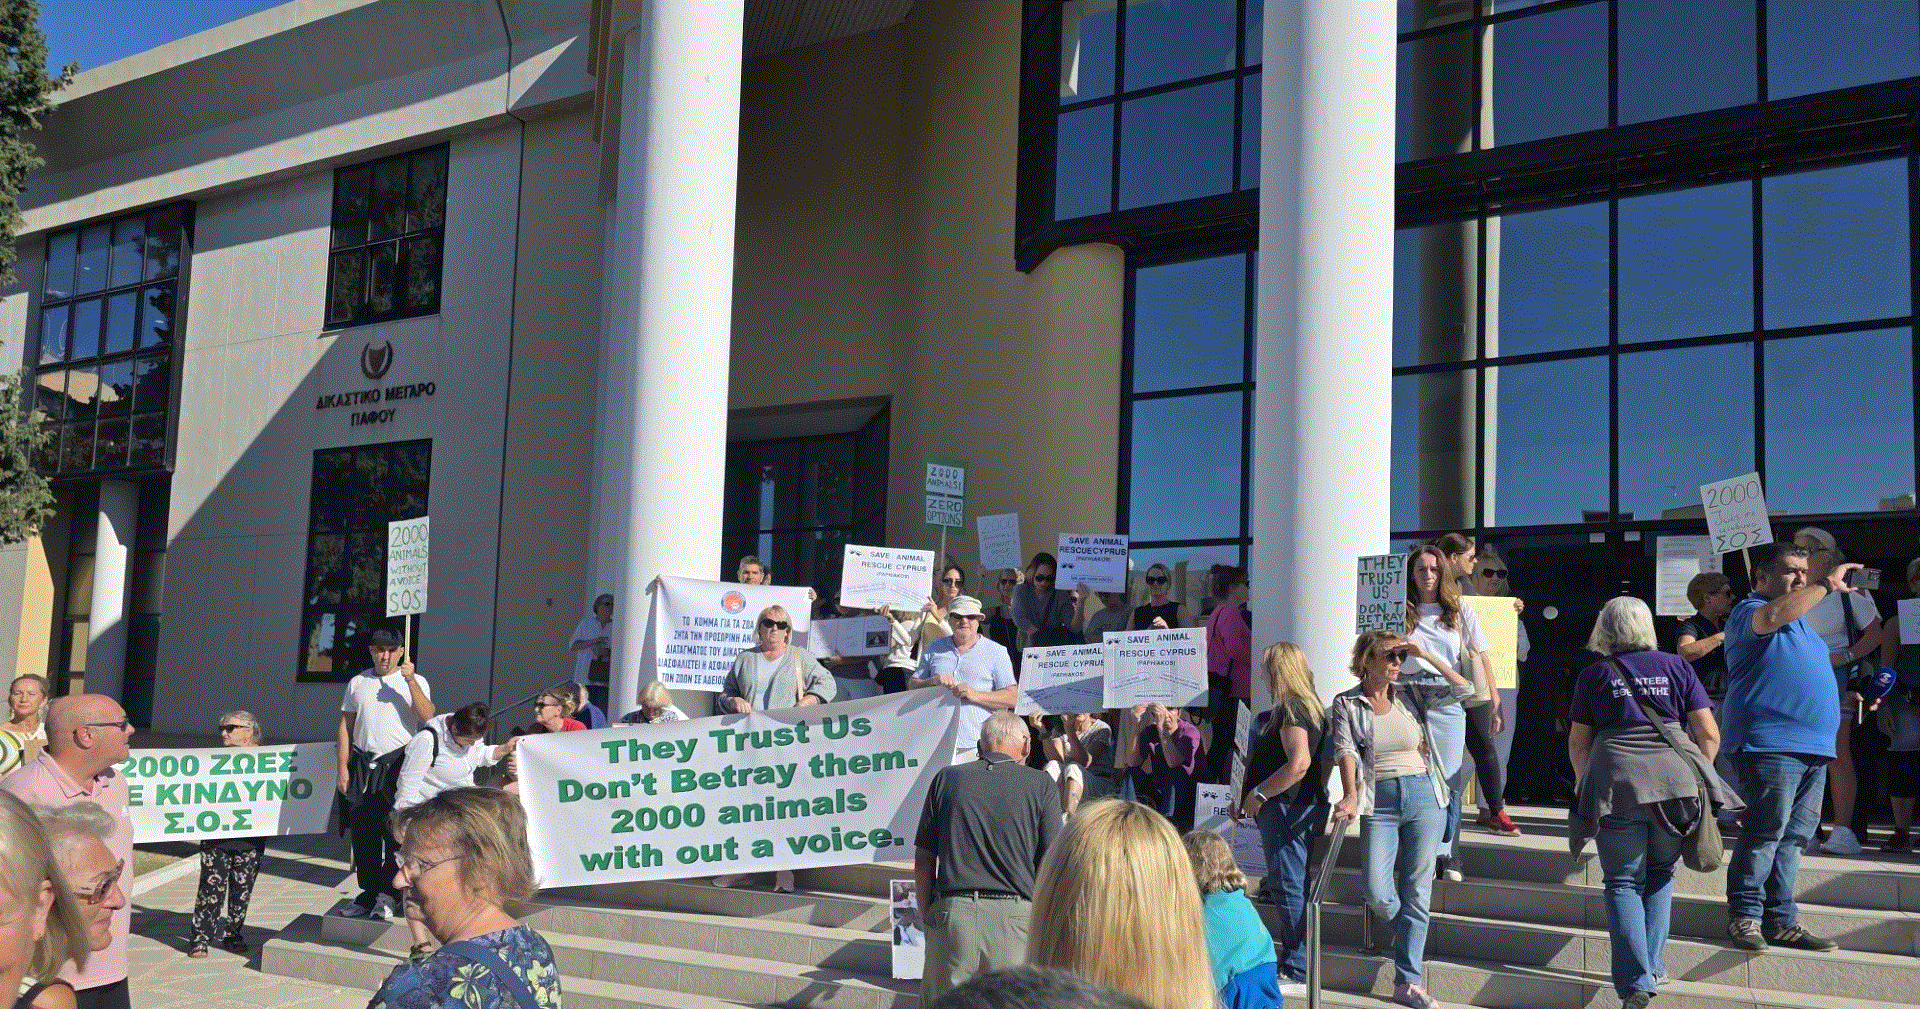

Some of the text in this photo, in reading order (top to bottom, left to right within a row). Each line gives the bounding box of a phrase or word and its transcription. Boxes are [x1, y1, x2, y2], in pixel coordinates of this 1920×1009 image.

[316, 381, 436, 410] ΔΙΚΑΣΤΙΚΟ ΜΕΓΑΡΟ
[351, 408, 396, 427] ΠΑΦΟΥ
[930, 467, 958, 480] 2000
[1707, 480, 1760, 509] 2000
[927, 498, 962, 512] ZERO
[926, 510, 962, 526] OPTIONS
[391, 523, 428, 547] 2000
[1069, 536, 1124, 546] SAVE ANIMAL
[1716, 528, 1765, 553] ΣΟΣ
[389, 545, 428, 561] ANIMALS
[870, 551, 925, 562] SAVE ANIMAL
[391, 562, 427, 574] WITHOUT
[861, 561, 927, 572] RESCUE CYPRUS
[1359, 555, 1405, 570] THEY
[1359, 571, 1402, 585] TRUST
[1372, 585, 1389, 599] US
[389, 588, 421, 613] SOS
[1359, 600, 1402, 614] DON'T
[682, 616, 691, 626] ΤΟ
[694, 617, 718, 628] ΚΟΜΜΑ
[720, 618, 731, 628] ΓΙΑ
[733, 619, 740, 629] ΤΑ
[1358, 612, 1404, 624] BETRAY
[1127, 633, 1191, 644] SAVE ANIMAL
[709, 646, 720, 656] ΤΟΥ
[1045, 647, 1102, 657] SAVE ANIMAL
[1119, 647, 1197, 658] RESCUE CYPRUS
[1038, 660, 1069, 669] RESCUE
[1611, 676, 1669, 687] VONTEER
[600, 714, 872, 765] They Trust Us
[121, 751, 298, 778] 2000 ΖΩΕΣ
[557, 748, 919, 803] Don't Betray them.
[156, 778, 313, 806] ΚΙΝΔΥΝΟ
[610, 787, 868, 834] 2000 animals
[164, 809, 253, 834] Σ.Ο.Σ
[579, 825, 904, 872] with out a voice.
